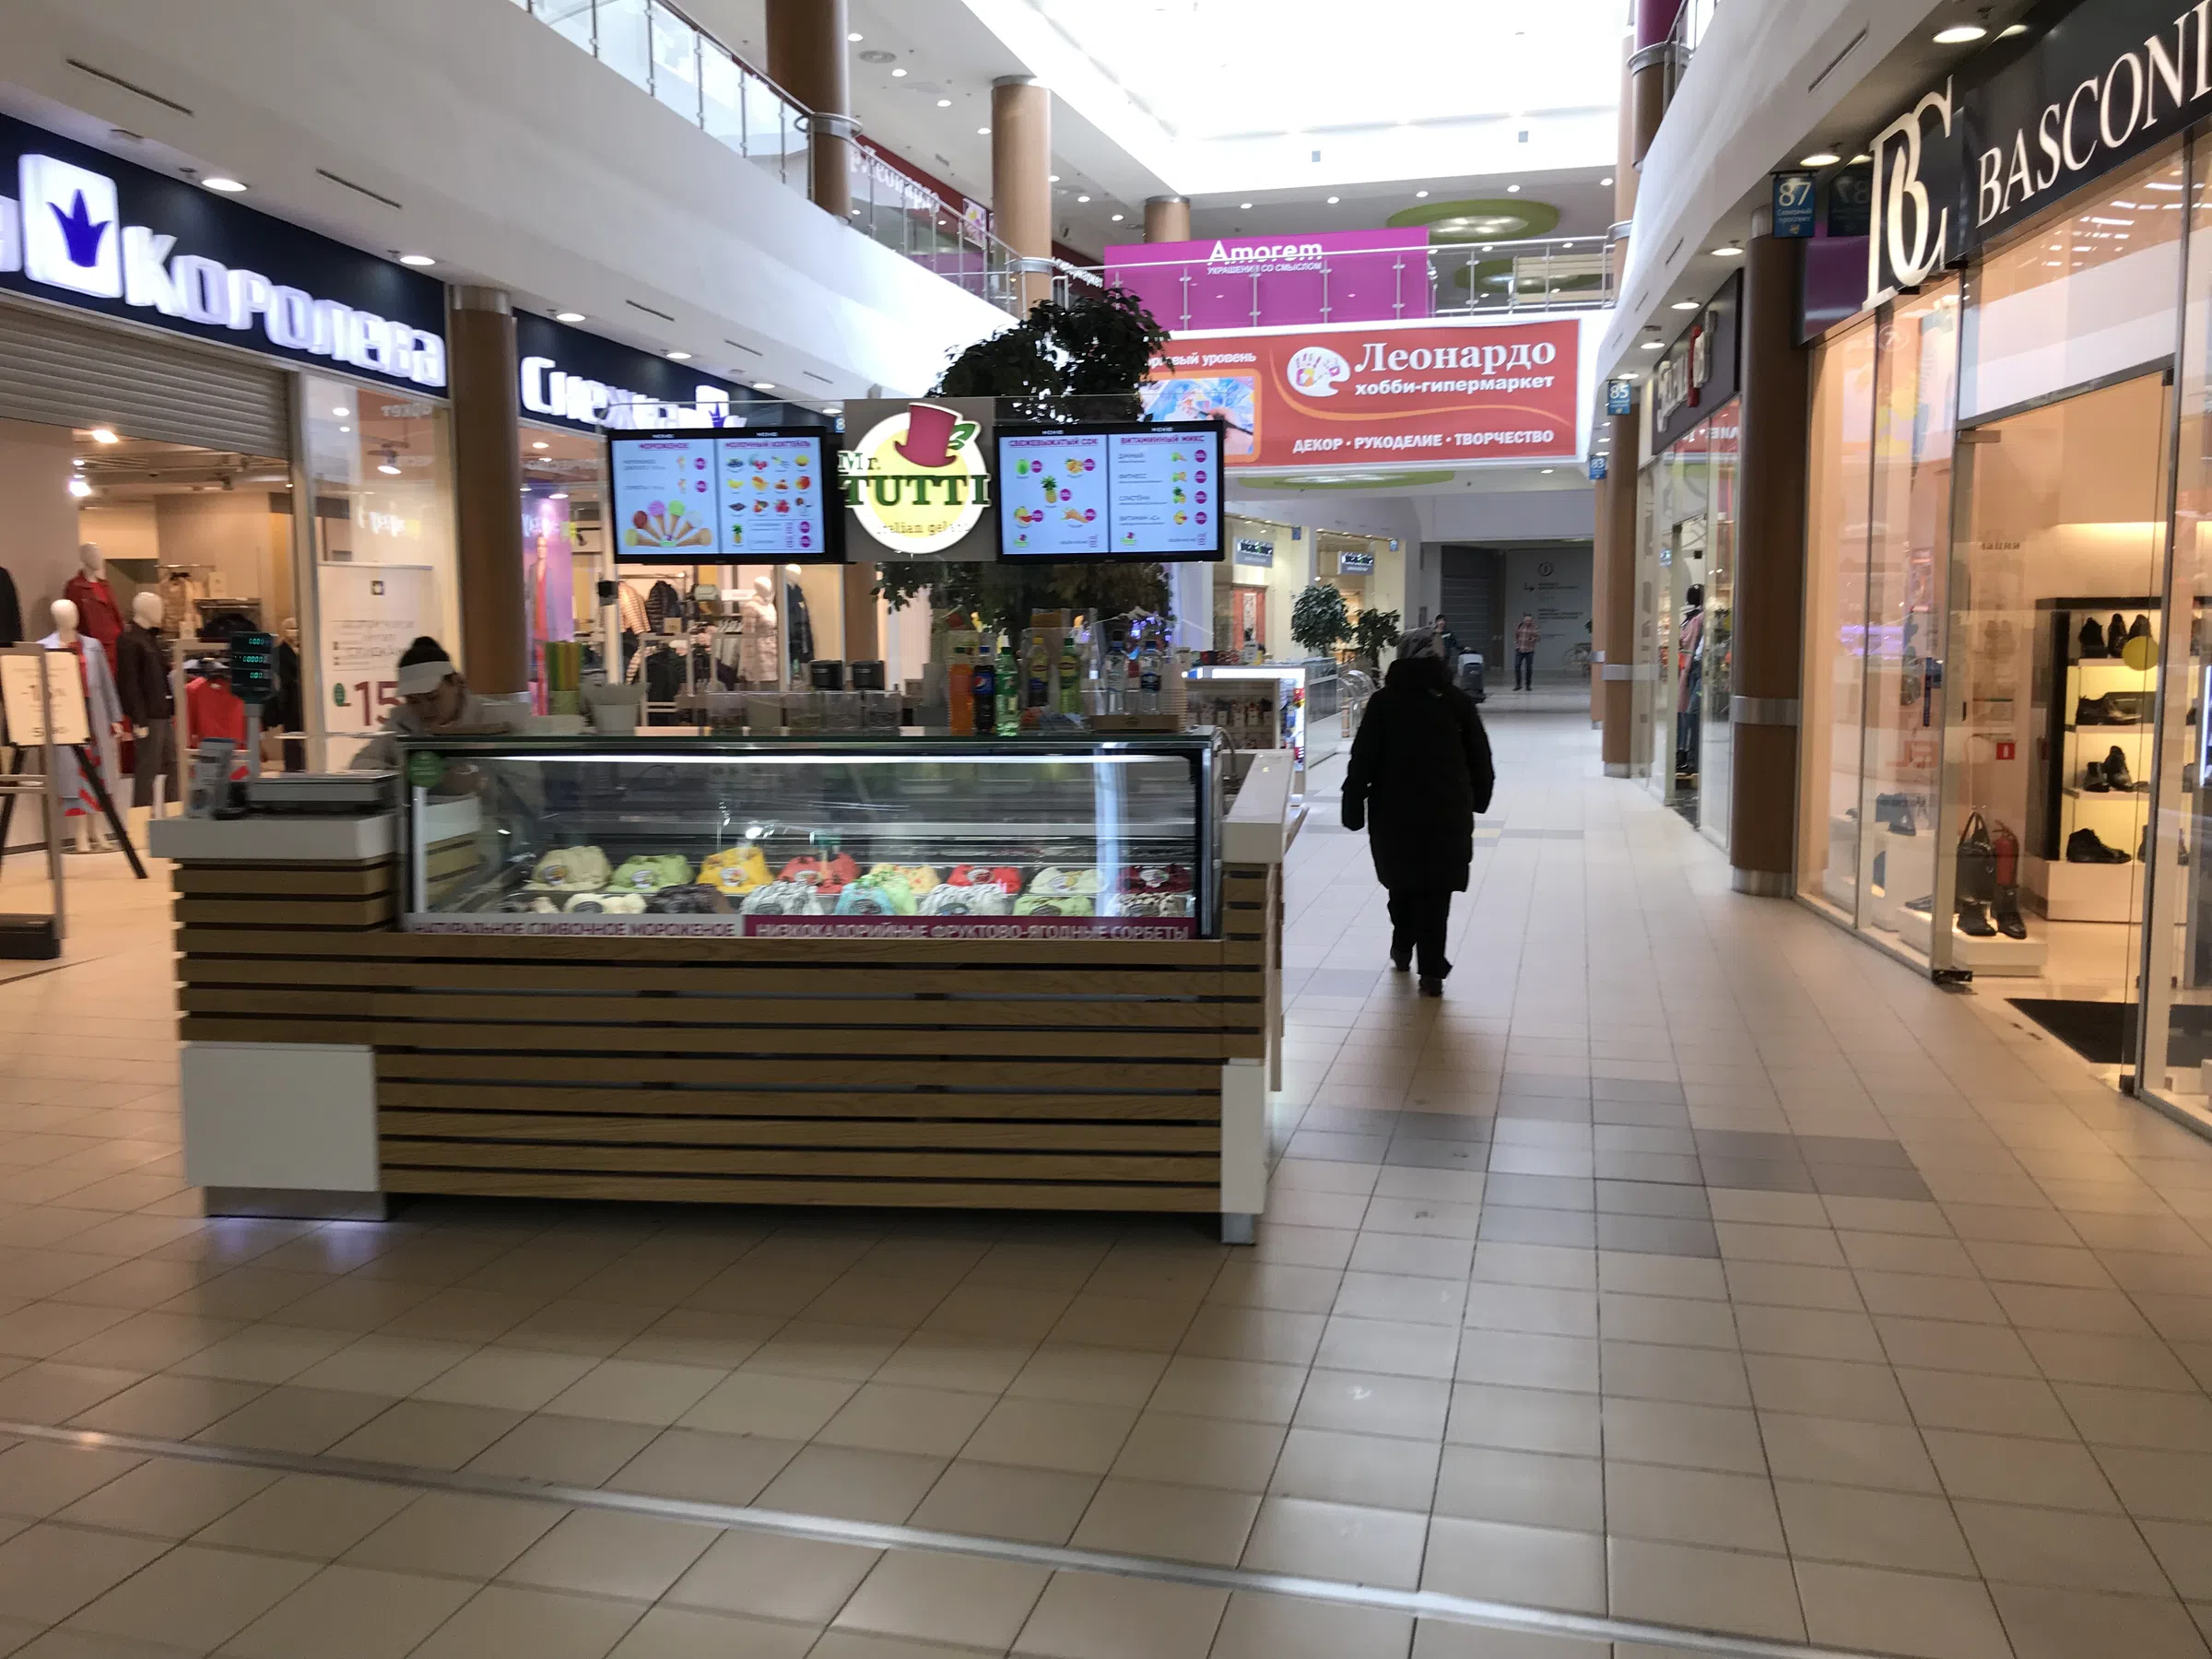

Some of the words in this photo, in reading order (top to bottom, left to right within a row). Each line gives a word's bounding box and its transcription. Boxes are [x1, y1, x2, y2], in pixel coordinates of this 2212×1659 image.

[1779, 181, 1811, 206] 87
[1207, 239, 1323, 265] Amorem
[1276, 262, 1323, 272] СМЫСЛОМ
[122, 225, 447, 387] Королева
[1201, 352, 1257, 367] уровень
[1354, 342, 1557, 375] Леонардо
[1354, 375, 1556, 395] хобби-гипермаркет
[1610, 384, 1629, 399] 85
[1121, 435, 1180, 444] ВИТАМИННЫЙ
[1292, 438, 1344, 453] ДЕКОР
[1354, 434, 1442, 450] РУКОДЕЛИЕ
[1454, 429, 1555, 446] ТВОРЧЕСТВО
[837, 452, 882, 471] Mr.
[839, 475, 991, 506] TUTTI
[877, 523, 924, 535] alian
[629, 924, 735, 936] МОРОЖЕНОЕ
[756, 922, 928, 937] НИЗКОКАЛОРИЙНЫЕ
[930, 924, 1108, 938] ФРУКТОВО-ЯГОДНЫЕ
[1110, 925, 1189, 939] СОРБЕТЫ
